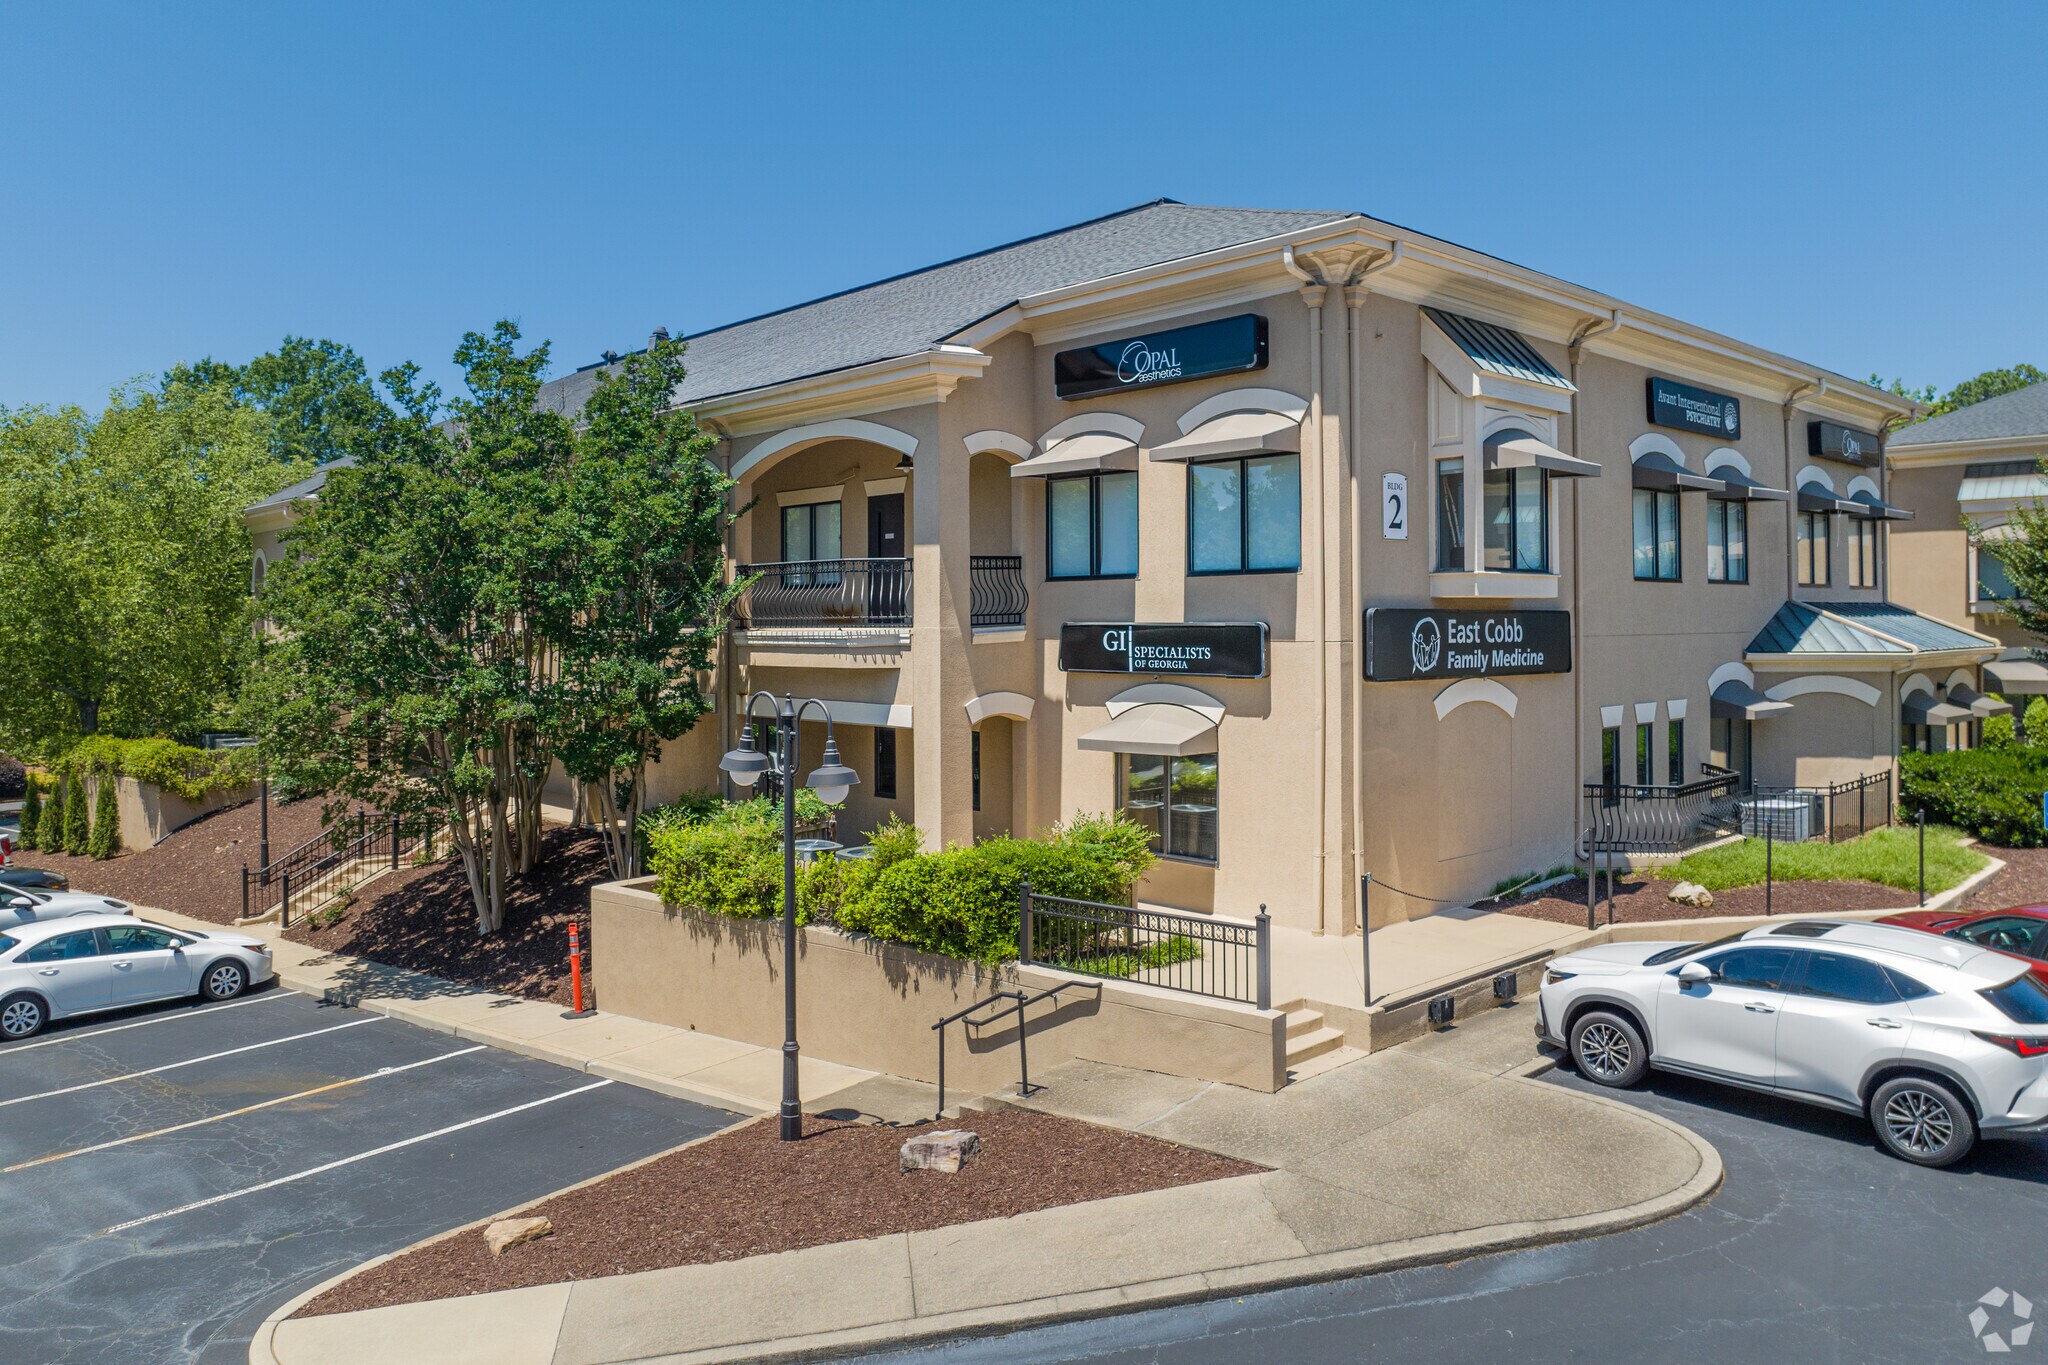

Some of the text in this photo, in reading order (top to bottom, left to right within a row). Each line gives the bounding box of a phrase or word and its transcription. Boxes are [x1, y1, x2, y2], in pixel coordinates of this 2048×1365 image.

[1658, 389, 1677, 406] Avant
[1686, 410, 1721, 428] PSYCHIATRY
[1387, 482, 1403, 491] BLDG
[1388, 494, 1402, 529] 2
[1448, 617, 1523, 644] East Cobb
[1103, 631, 1126, 650] GI
[1134, 646, 1211, 660] SPECIALISTS
[1447, 649, 1544, 673] Family Medicine
[1134, 659, 1188, 669] OF GEORGIA
